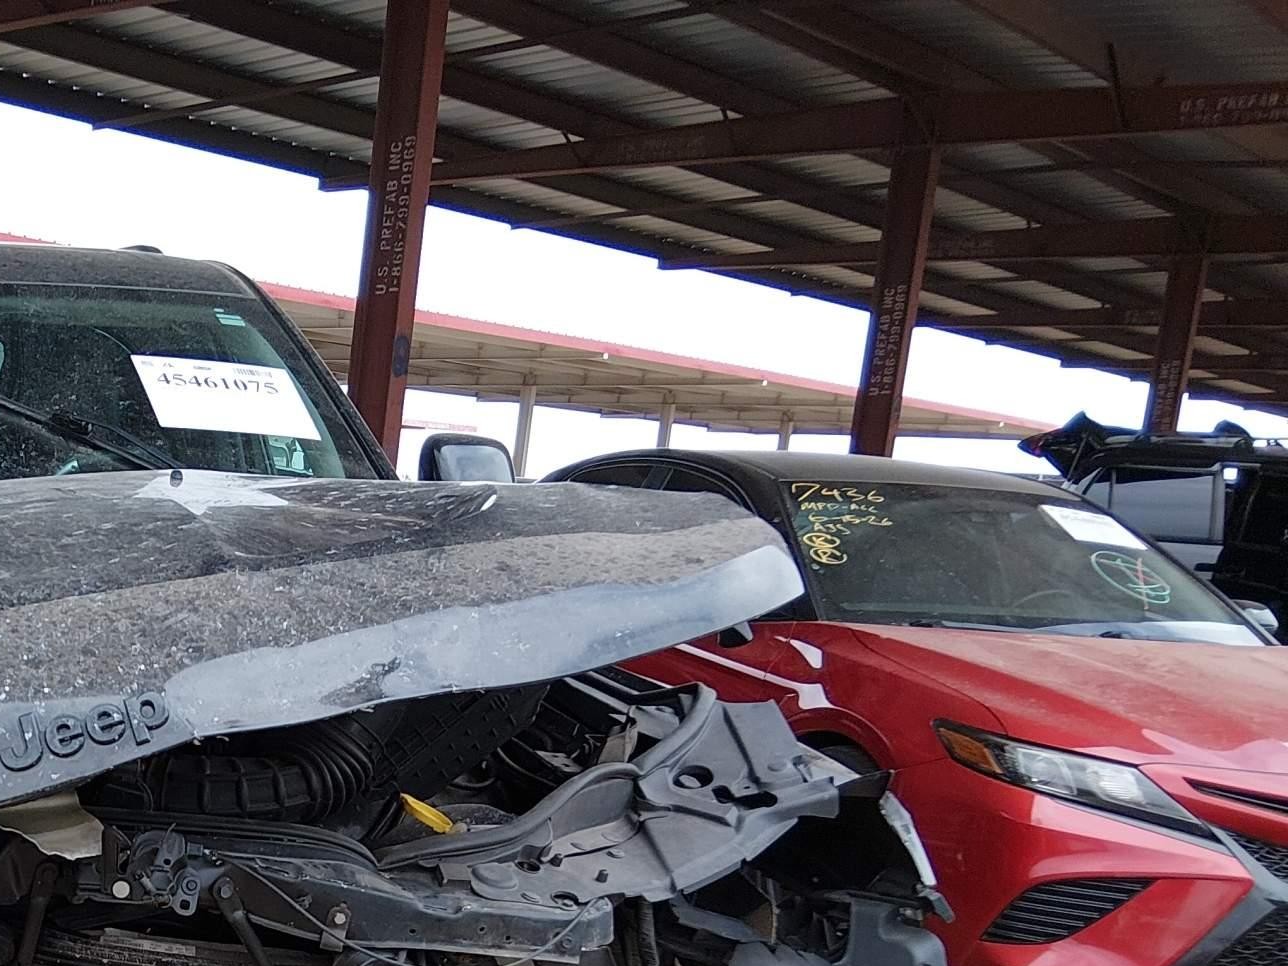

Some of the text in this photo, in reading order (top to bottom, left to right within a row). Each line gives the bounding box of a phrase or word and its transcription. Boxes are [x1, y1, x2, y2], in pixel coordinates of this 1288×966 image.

[374, 140, 402, 295] U.S. PREFAB INC
[388, 134, 417, 293] 1-866-799-0969
[872, 313, 891, 366] PREFAB
[157, 371, 280, 395] 45461075
[868, 371, 882, 397] U.S.
[791, 482, 885, 503] 7436
